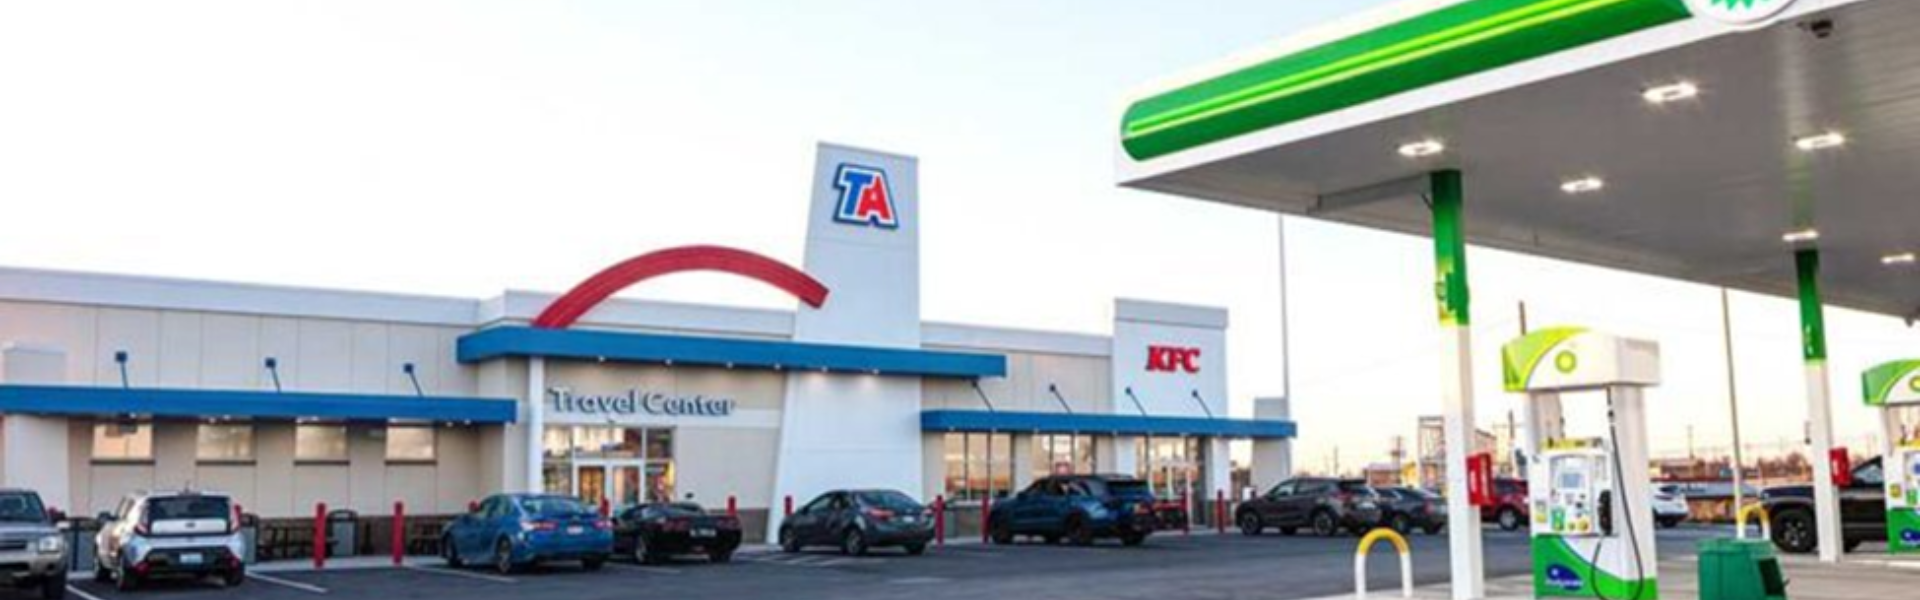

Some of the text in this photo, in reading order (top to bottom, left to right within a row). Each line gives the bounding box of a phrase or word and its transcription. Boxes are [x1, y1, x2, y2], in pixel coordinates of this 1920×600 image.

[837, 166, 895, 224] TA
[1145, 345, 1201, 373] KFC
[548, 388, 735, 416] Travel Center
